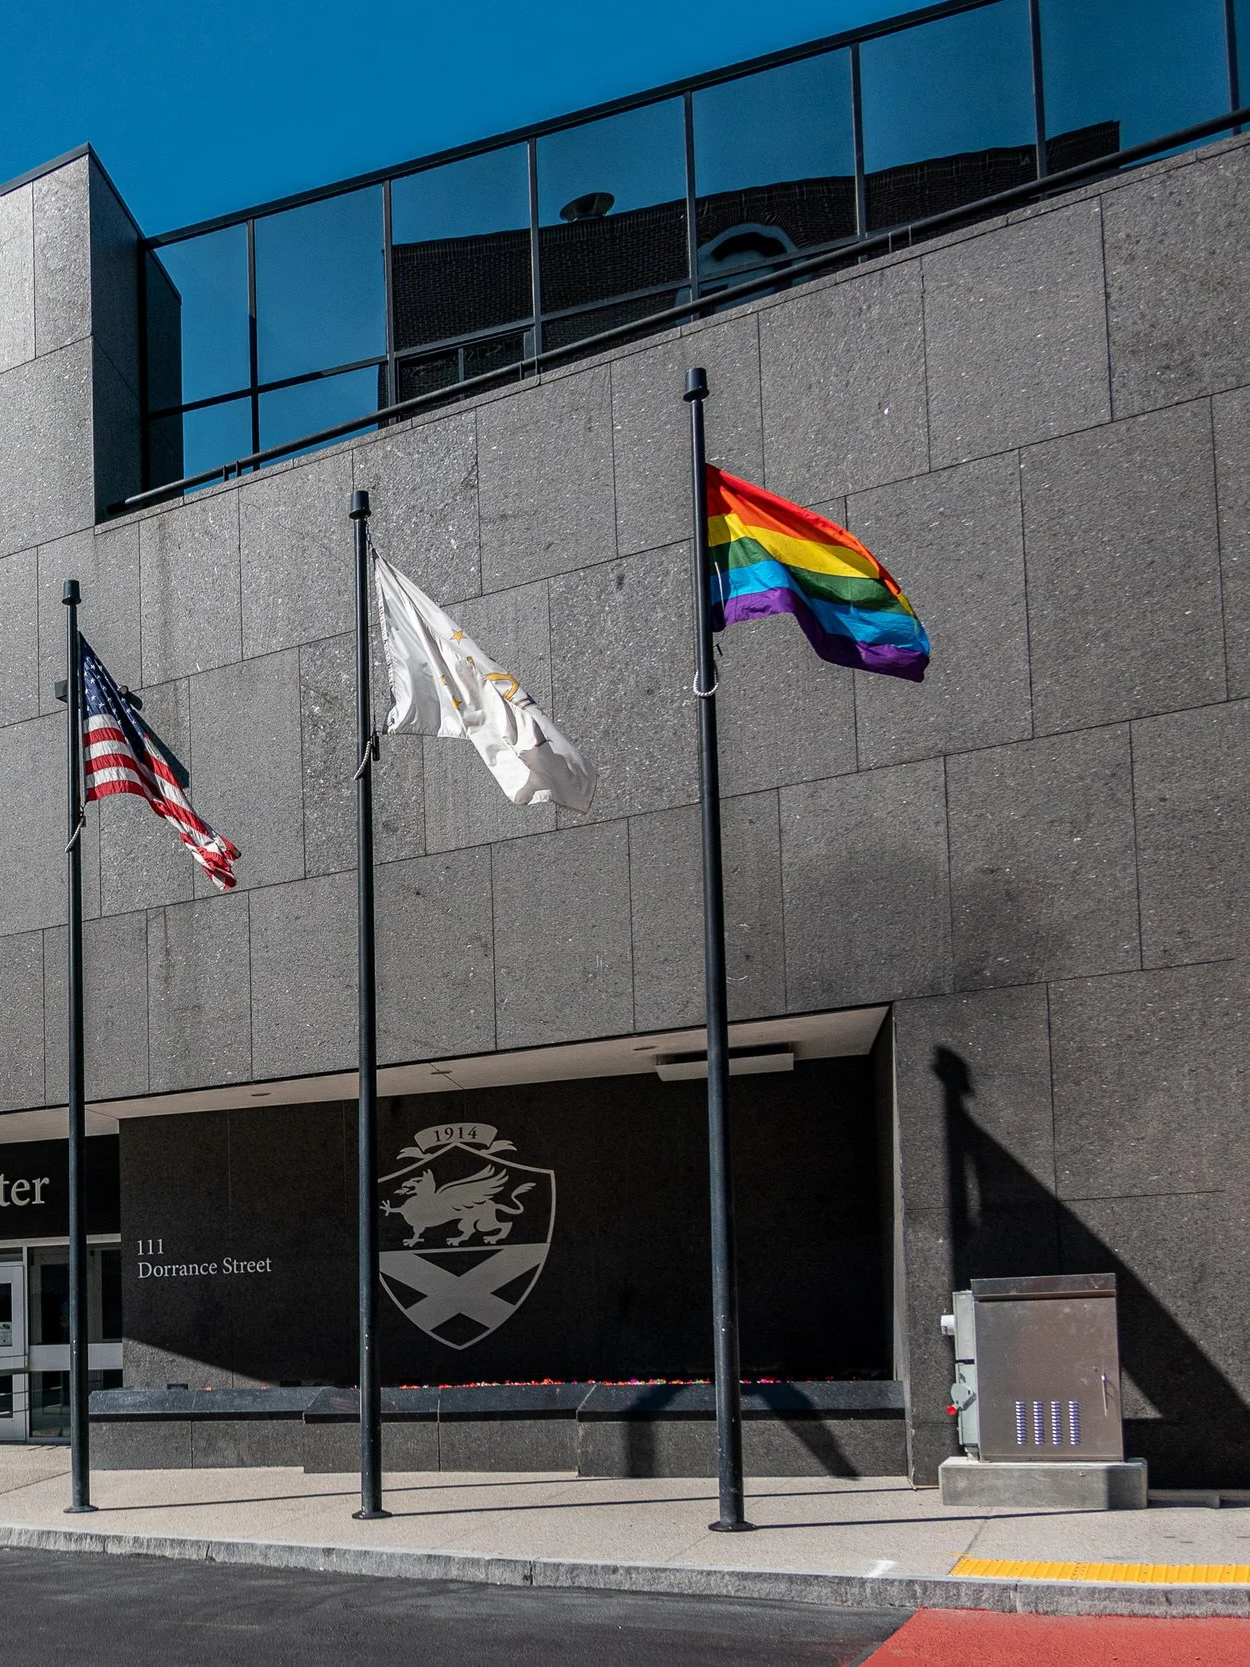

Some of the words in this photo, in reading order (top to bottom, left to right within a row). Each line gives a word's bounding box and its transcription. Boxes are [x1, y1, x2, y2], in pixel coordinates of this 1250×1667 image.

[433, 1125, 479, 1143] 1914
[136, 1238, 164, 1256] 111
[137, 1259, 218, 1280] Dorrance
[222, 1255, 273, 1276] Street
